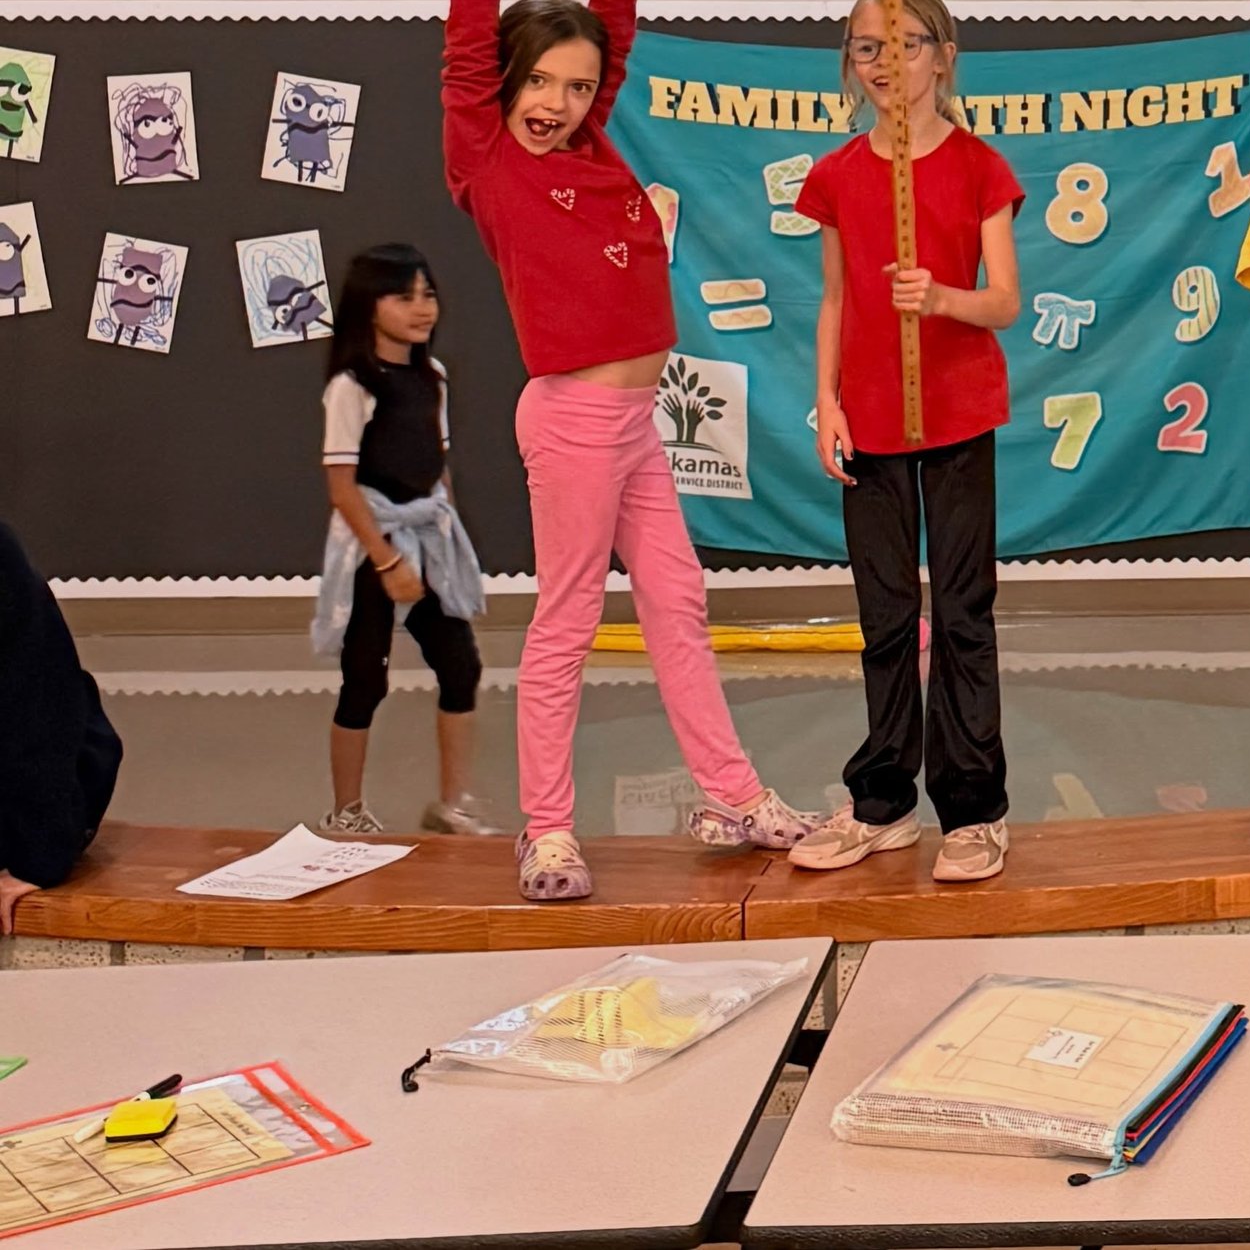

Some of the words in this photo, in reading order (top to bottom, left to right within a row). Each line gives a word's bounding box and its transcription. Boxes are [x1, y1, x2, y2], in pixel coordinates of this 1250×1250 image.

[648, 75, 854, 134] FAMILY
[955, 93, 1048, 137] TH
[1059, 73, 1246, 132] NIGHT
[1045, 162, 1109, 245] 8
[1172, 265, 1221, 344] 9
[1043, 391, 1102, 471] 7
[1157, 381, 1208, 455] 2
[671, 451, 742, 478] kamas
[675, 476, 705, 488] ERVICE
